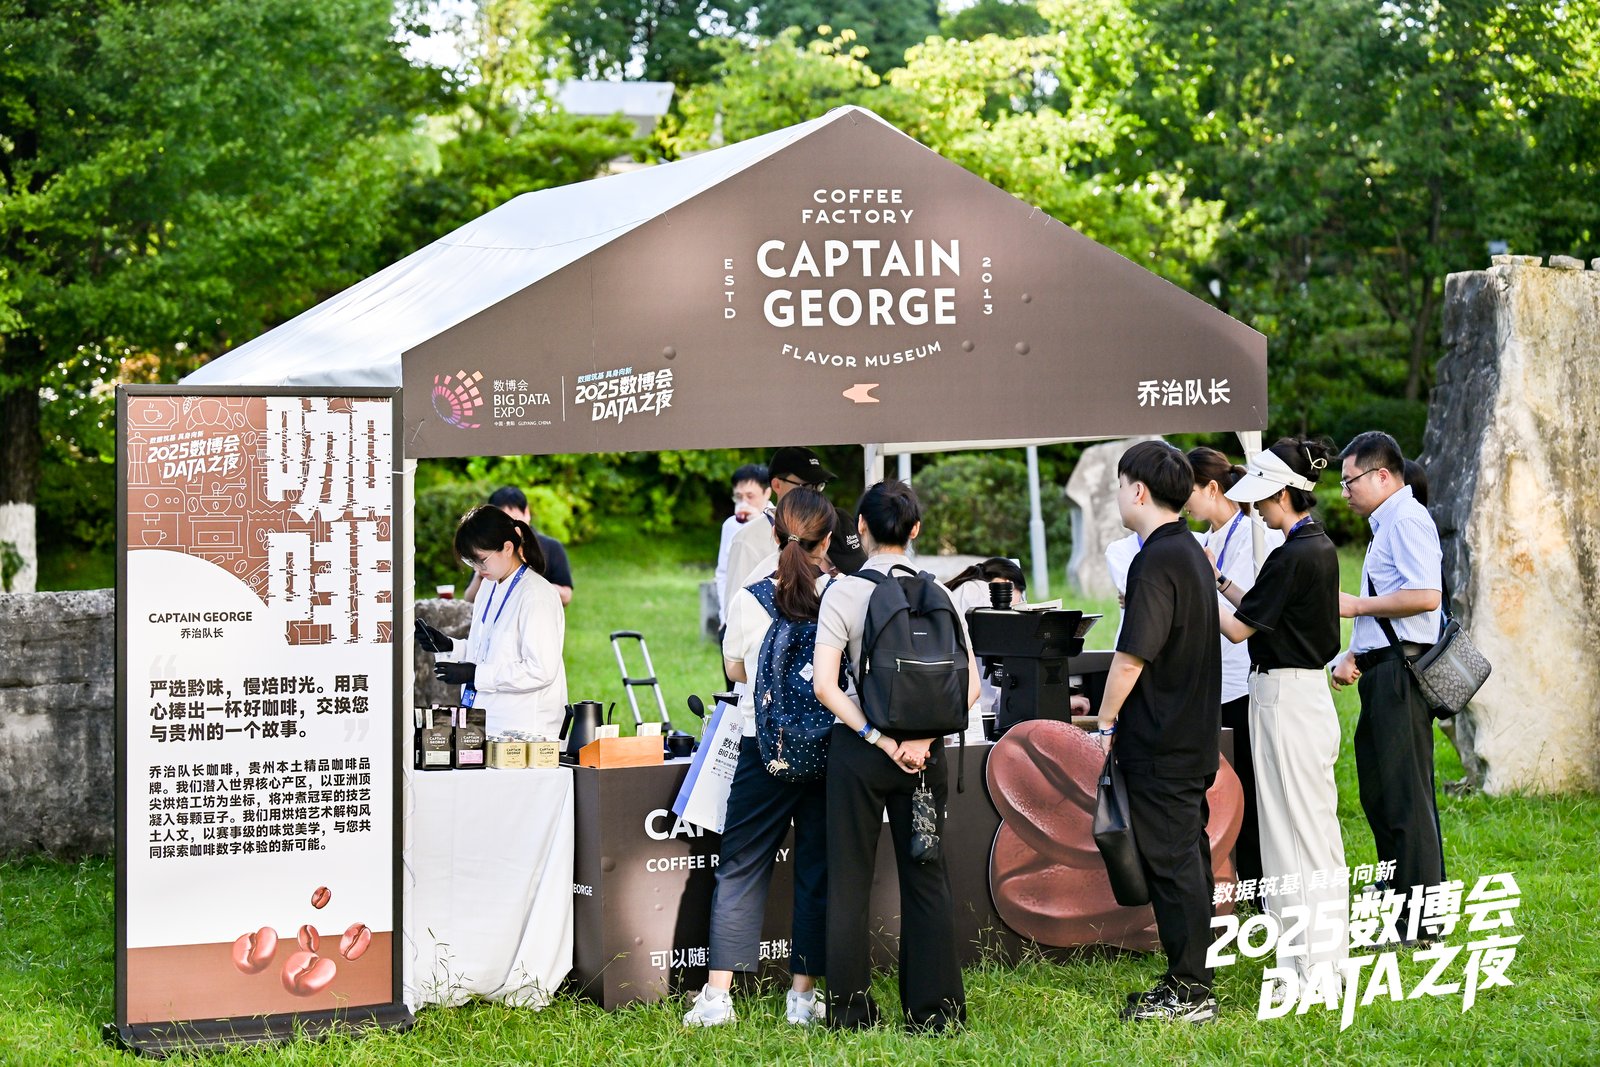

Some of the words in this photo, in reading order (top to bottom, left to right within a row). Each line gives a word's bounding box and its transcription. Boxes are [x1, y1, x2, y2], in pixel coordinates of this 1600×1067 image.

[813, 188, 903, 204] COFFEE
[801, 209, 914, 224] FACTORY
[756, 239, 961, 279] CAPTAIN
[724, 258, 736, 319] ESTD
[982, 257, 993, 315] 2013
[763, 288, 957, 328] GEORGE
[782, 343, 857, 368] FLAVOR
[865, 341, 942, 368] MUSEUM
[493, 379, 529, 392] 数博会
[575, 368, 674, 404] 2025数博会
[1137, 378, 1231, 407] 乔治队长
[493, 395, 515, 406] BIG
[518, 394, 551, 406] DATA
[493, 407, 525, 418] EXPO
[147, 435, 240, 463] 2025数博会
[148, 612, 201, 624] CAPTAIN
[203, 611, 253, 623] GEORGE
[180, 628, 224, 639] 乔治队长
[150, 674, 369, 699] 严选黔味，慢焙时光。用真
[150, 696, 369, 721] 心捧出一杯好咖啡，交换您
[150, 720, 306, 743] 与贵州的一个故事。
[718, 748, 729, 757] BIG
[149, 757, 371, 779] 乔治队长咖啡，贵州本土精品咖啡品
[149, 773, 371, 795] 牌。我们潜入世界核心产区，以亚洲顶
[149, 788, 371, 811] 尖烘焙工坊为坐标，将冲煮冠军的技艺
[149, 804, 371, 827] 凝入每颗豆子。我们用烘焙艺术解构风
[149, 819, 371, 842] 土人文，以赛事级的味觉美学，与您共
[149, 837, 327, 859] 同探索咖啡数字体验的新可能。
[645, 857, 705, 873] COFFEE
